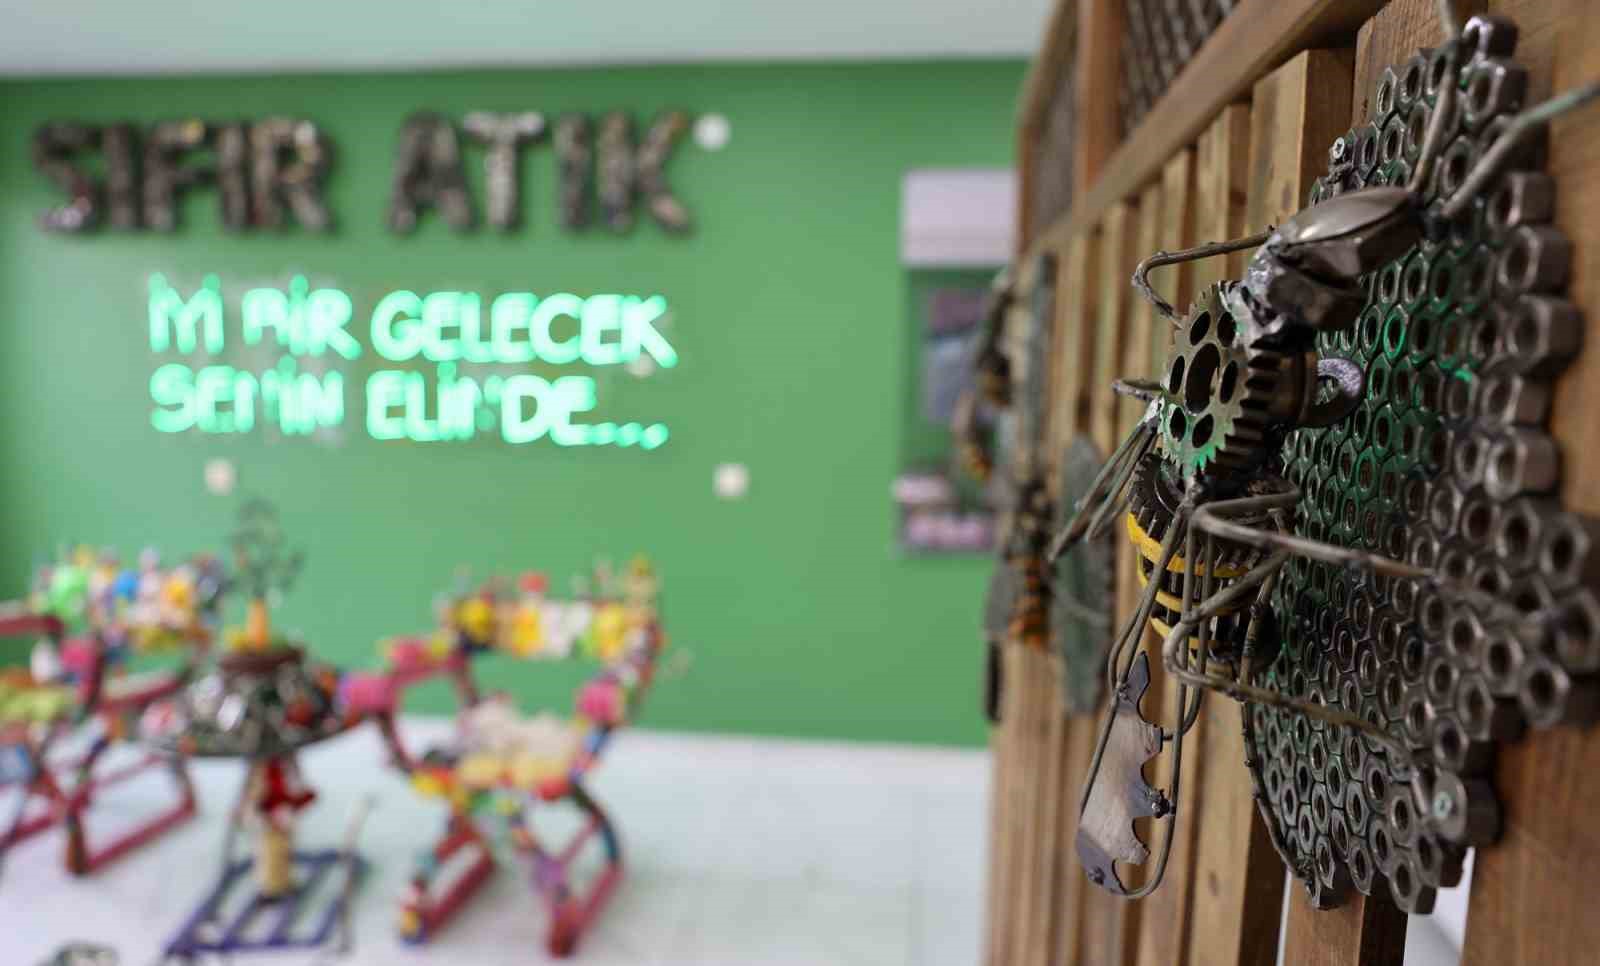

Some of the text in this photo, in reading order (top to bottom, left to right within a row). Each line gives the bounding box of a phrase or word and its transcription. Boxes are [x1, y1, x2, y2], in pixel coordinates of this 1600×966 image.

[32, 110, 694, 233] SIFIR ATIK
[370, 290, 678, 368] GELECEK
